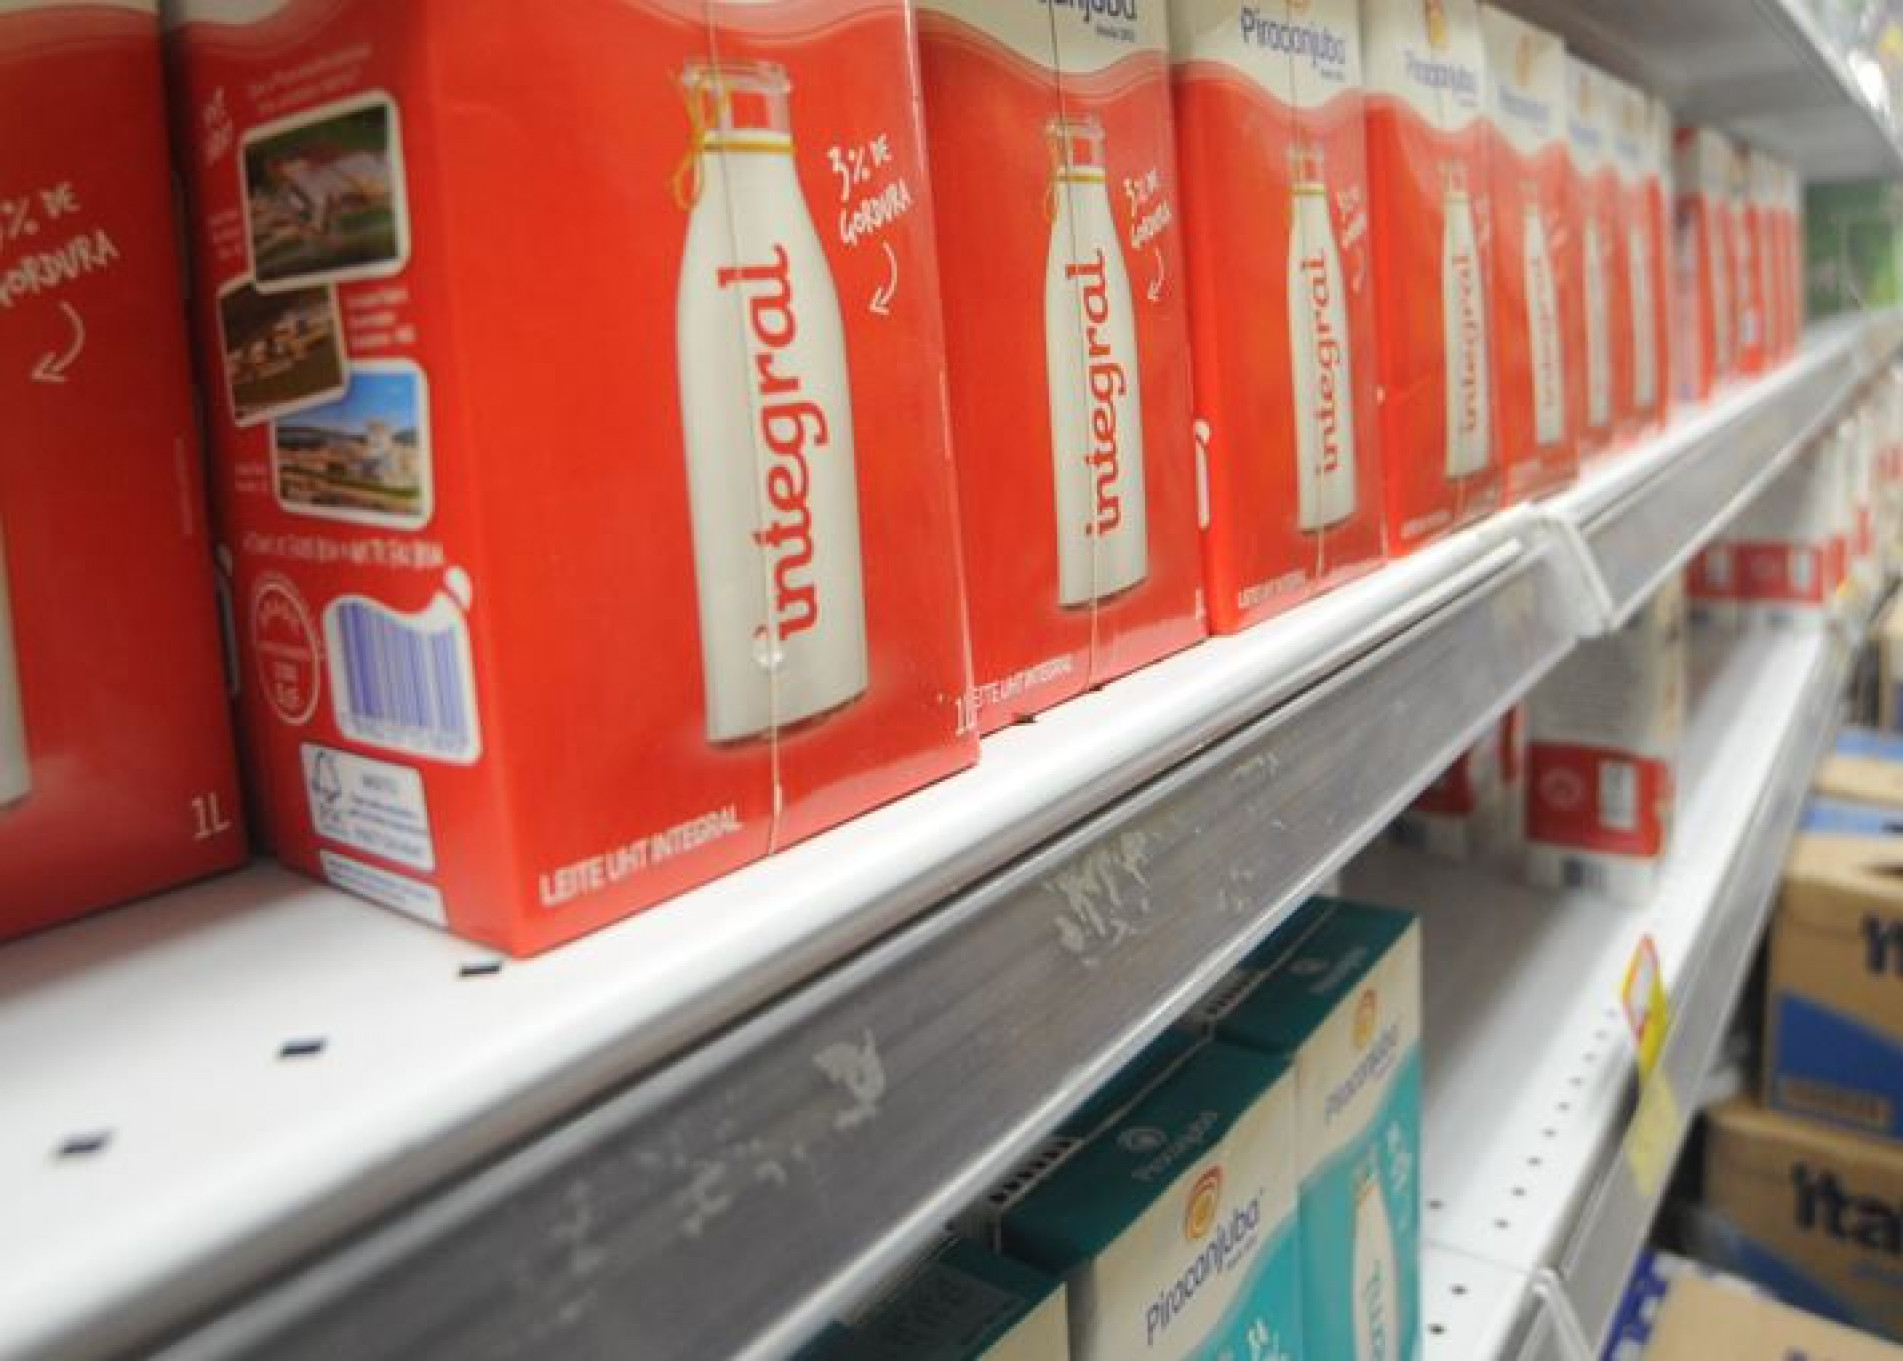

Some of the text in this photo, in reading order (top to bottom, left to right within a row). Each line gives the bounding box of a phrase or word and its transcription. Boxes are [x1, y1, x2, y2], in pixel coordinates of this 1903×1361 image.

[1240, 7, 1346, 67] Piracanjuba
[869, 132, 892, 168] DE
[40, 180, 81, 220] DE
[840, 178, 912, 247] GORDURA
[1066, 248, 1126, 536] integral
[1300, 248, 1342, 475] integral
[718, 243, 829, 641] integral
[190, 791, 232, 843] 1L
[538, 802, 744, 907] LEITE UHT INTEGRAL
[1146, 1197, 1260, 1346] Piracanjuba
